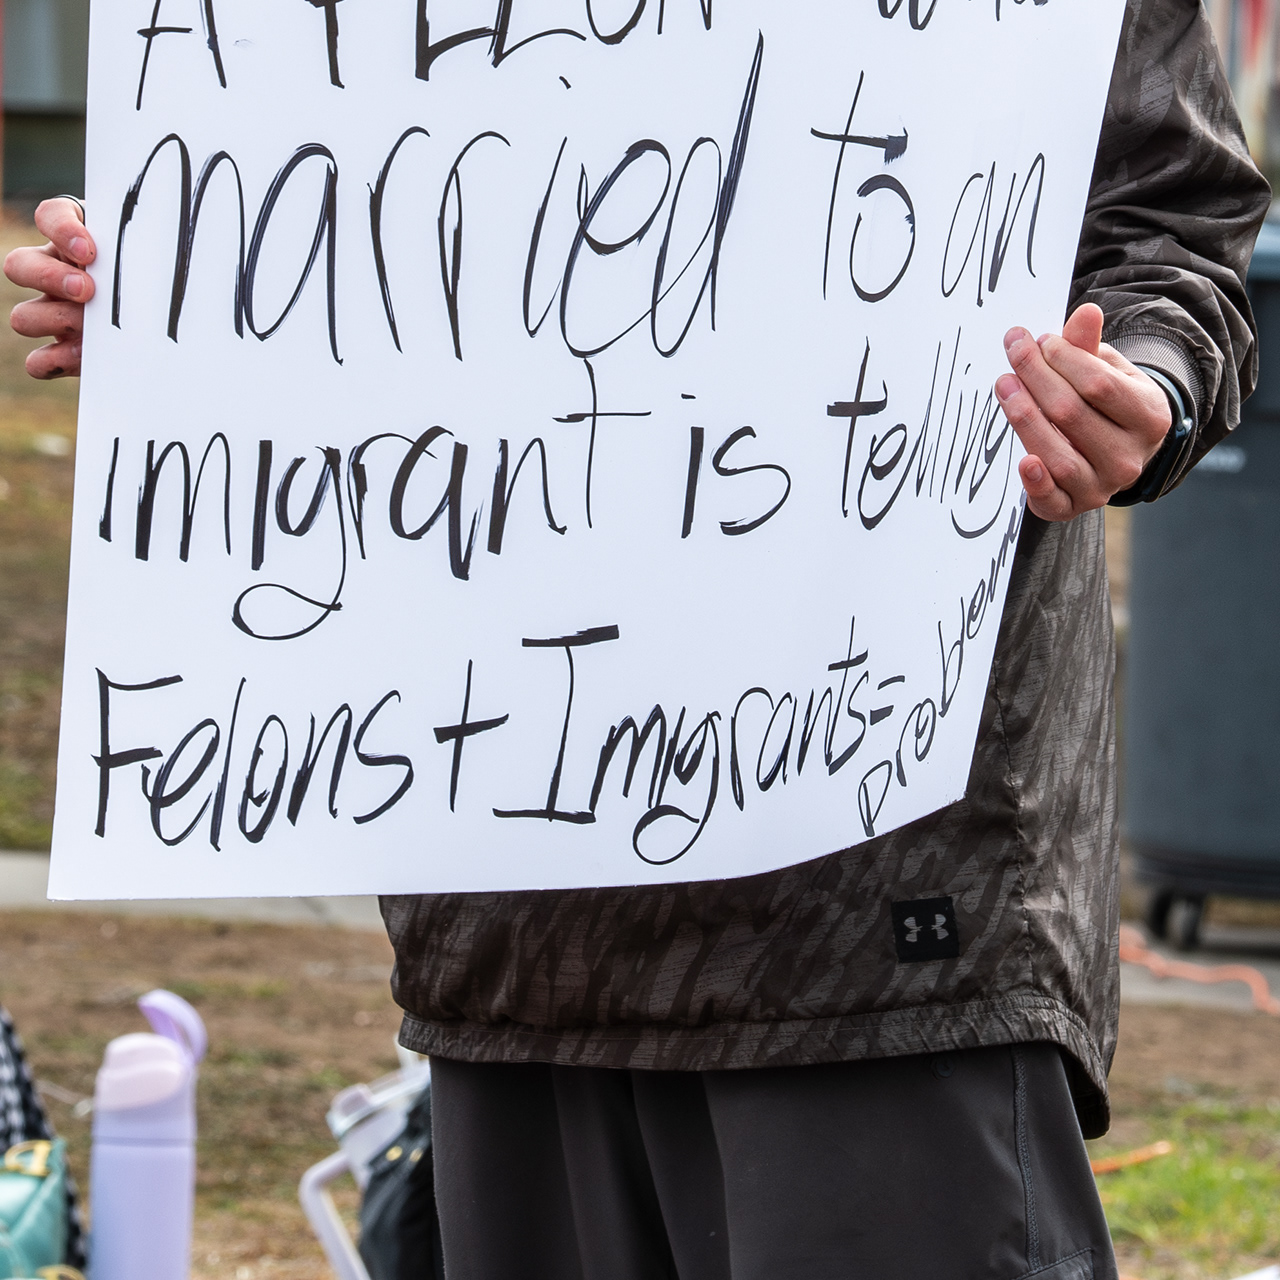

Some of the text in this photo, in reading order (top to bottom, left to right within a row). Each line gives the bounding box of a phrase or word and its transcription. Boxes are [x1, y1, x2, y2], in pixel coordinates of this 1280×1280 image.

[111, 30, 1046, 367] married to an
[680, 393, 792, 539] is
[826, 325, 1016, 540] telling
